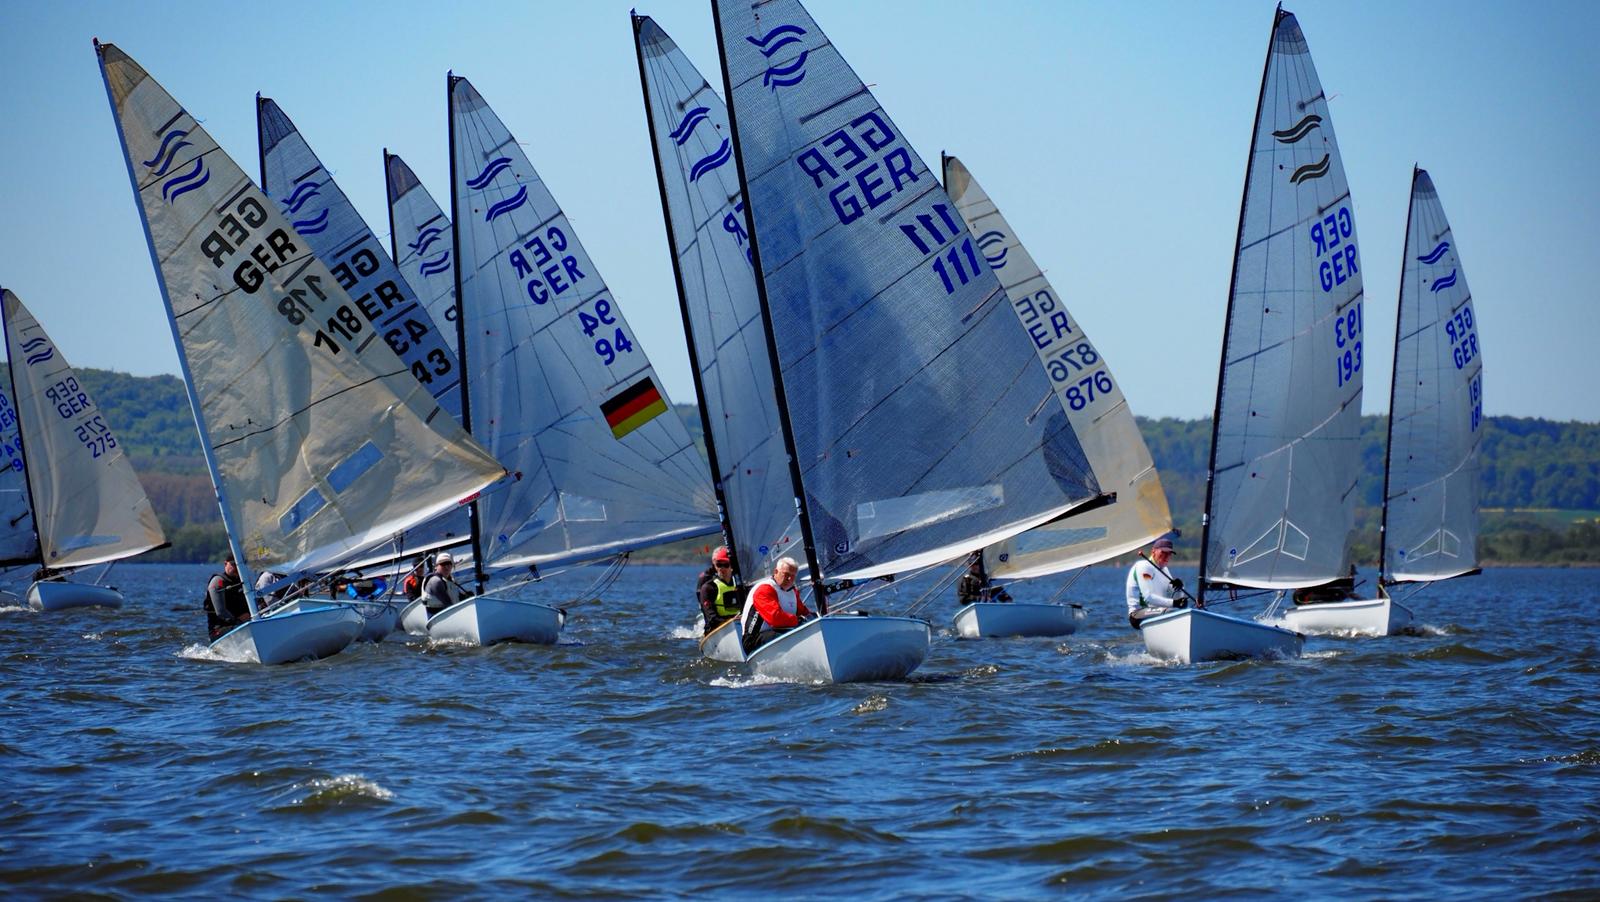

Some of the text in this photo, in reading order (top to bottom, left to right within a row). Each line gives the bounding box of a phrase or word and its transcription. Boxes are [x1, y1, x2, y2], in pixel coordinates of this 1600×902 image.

[828, 146, 920, 226] GER
[233, 228, 298, 294] GER
[527, 255, 586, 305] GER
[932, 237, 981, 296] 111
[1319, 243, 1359, 293] GER
[355, 280, 405, 322] ER
[313, 305, 362, 355] 118
[595, 327, 633, 366] 94
[1028, 311, 1072, 350] ER
[412, 348, 452, 385] 43
[1337, 341, 1362, 388] 193
[1453, 333, 1478, 371] GER
[57, 391, 91, 420] GER
[1065, 370, 1113, 412] 876
[86, 432, 117, 459] 275
